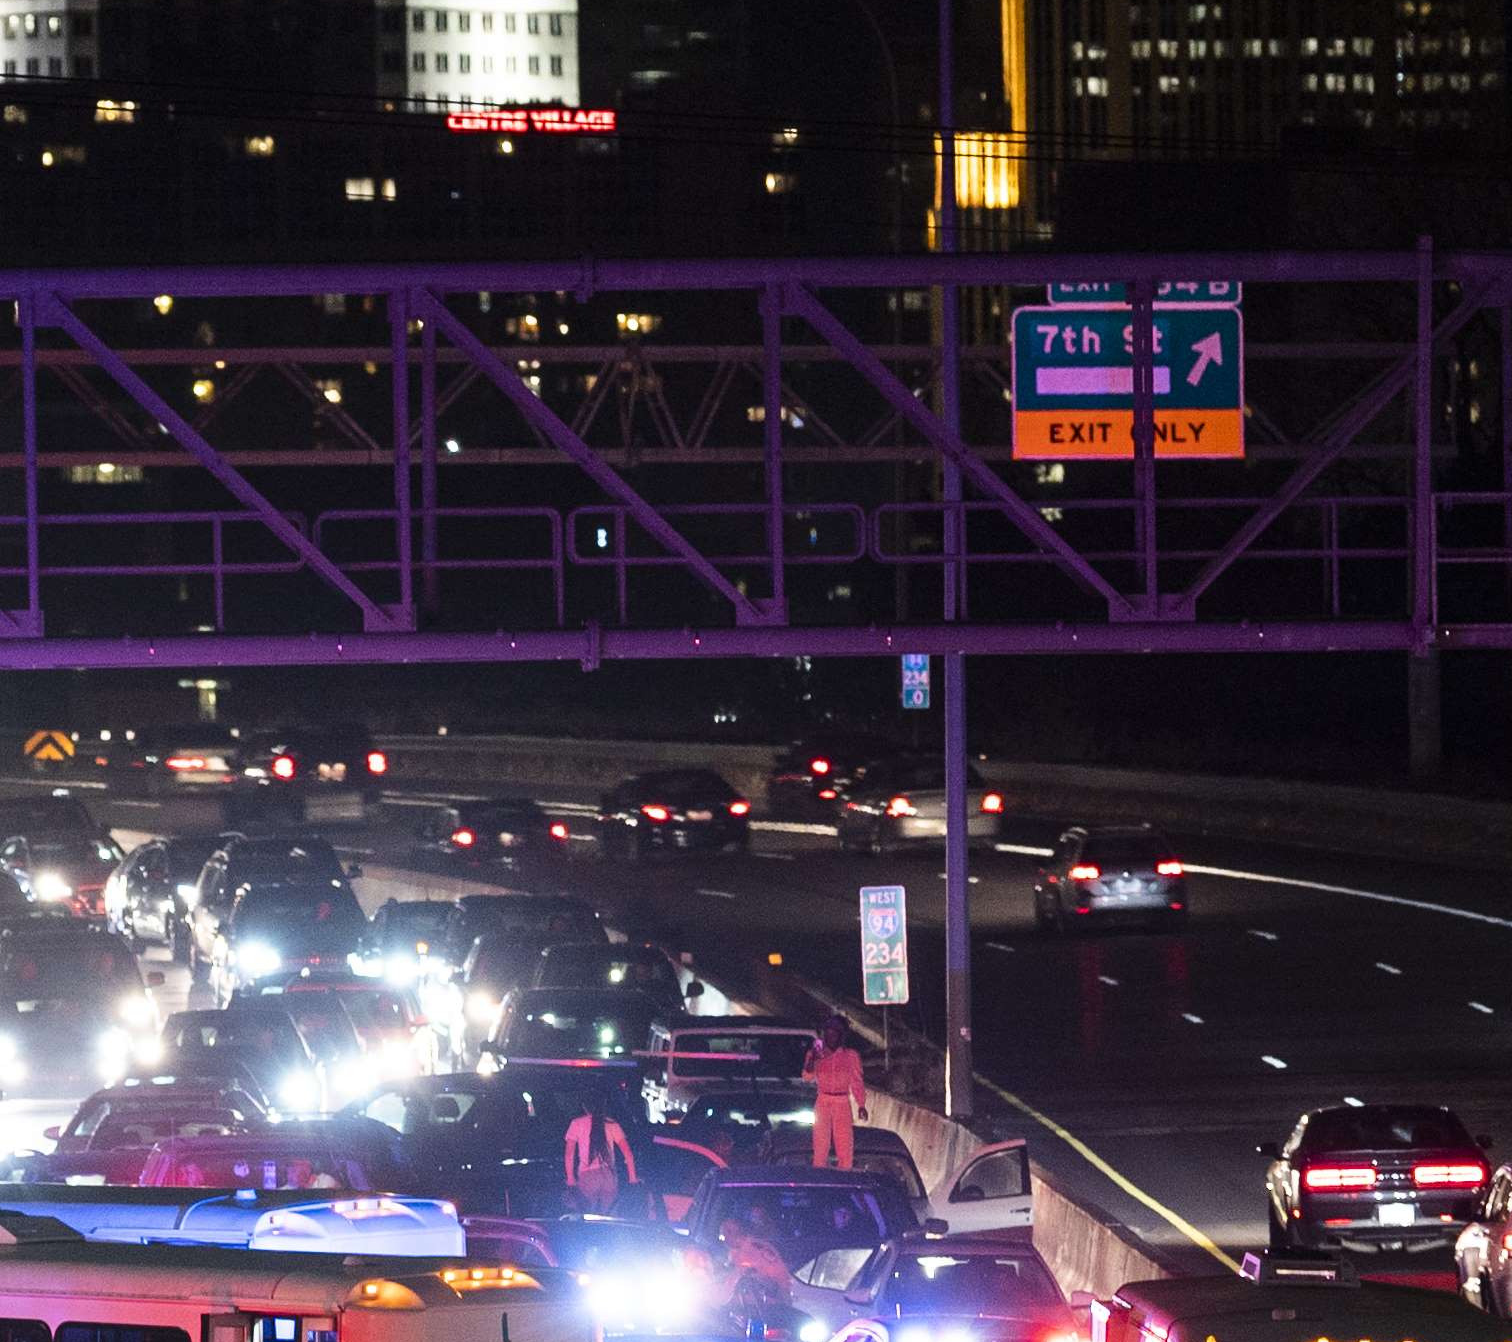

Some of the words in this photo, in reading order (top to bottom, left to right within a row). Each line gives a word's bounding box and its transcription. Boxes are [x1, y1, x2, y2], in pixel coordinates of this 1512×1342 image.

[1036, 325, 1101, 354] 7th
[1049, 423, 1113, 444] EXIT
[869, 892, 896, 904] WEST
[872, 915, 895, 931] 94
[865, 942, 904, 965] 234
